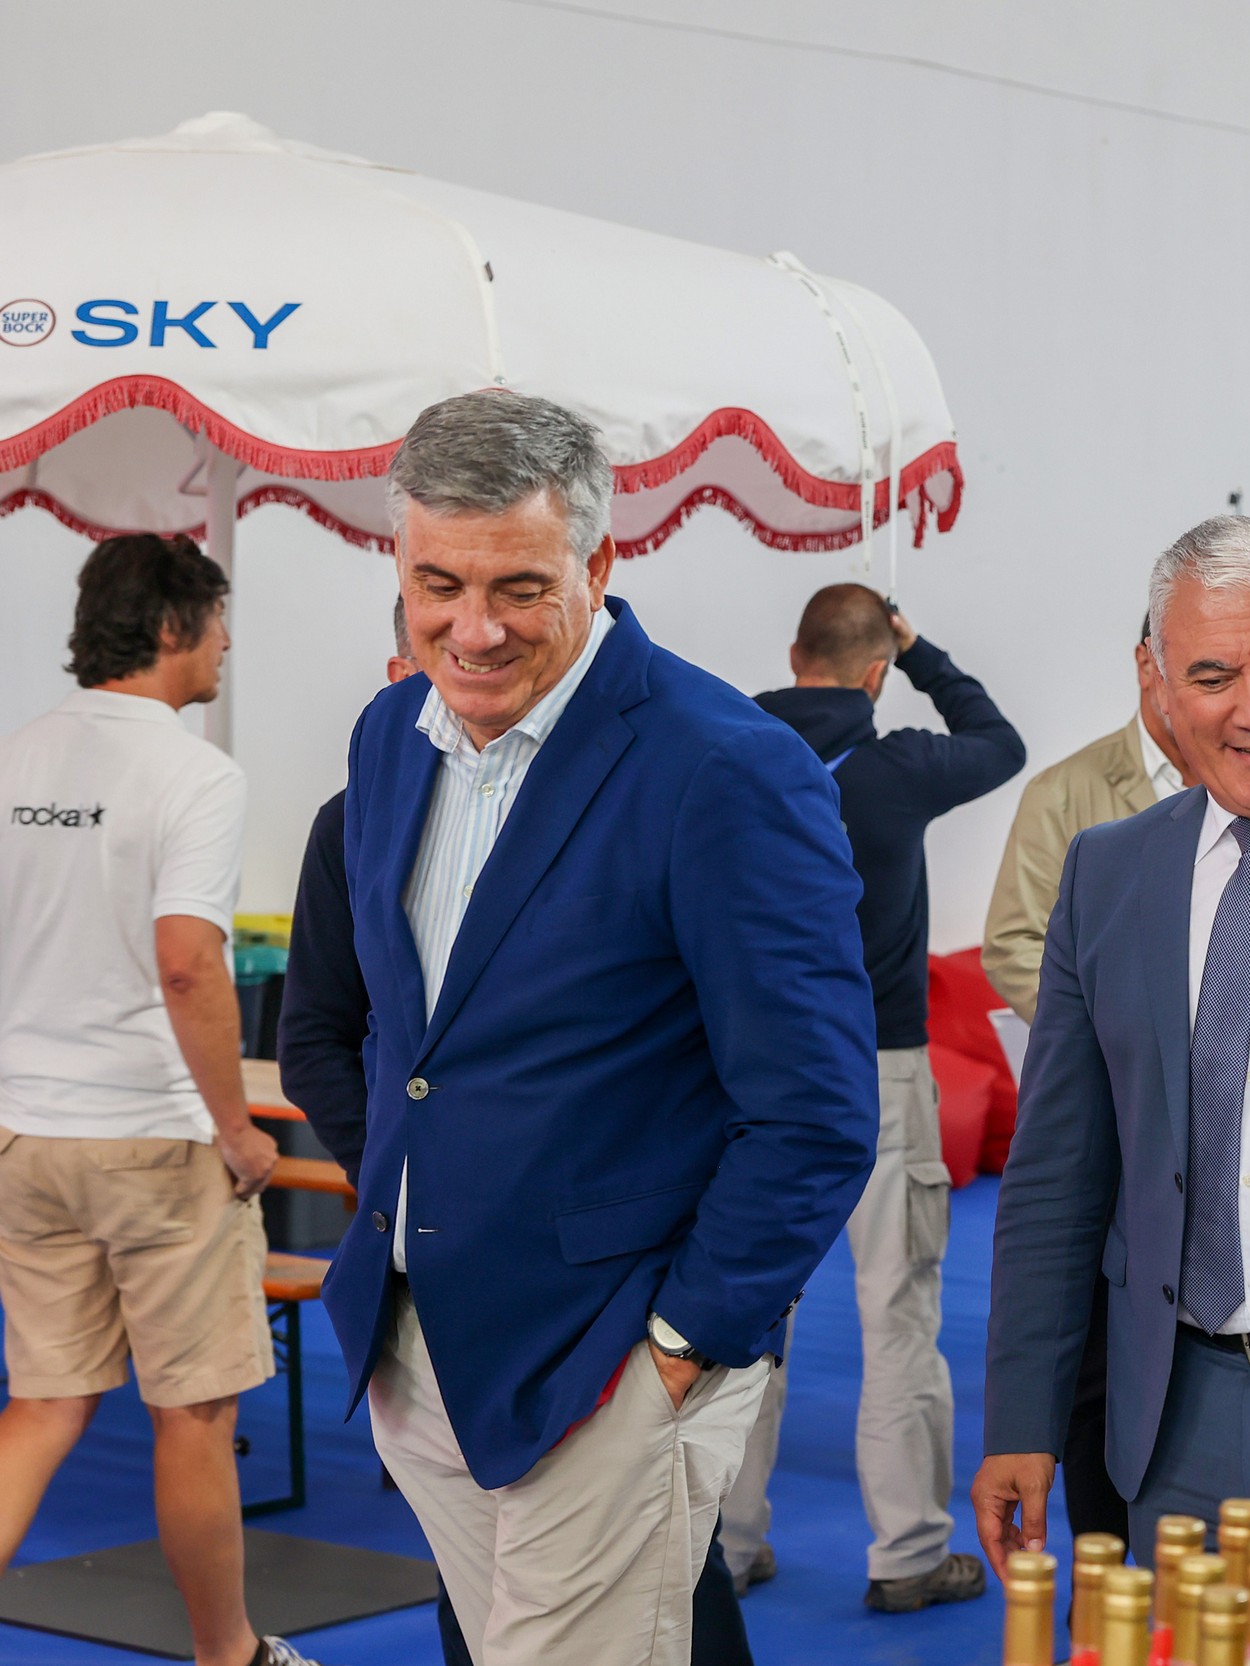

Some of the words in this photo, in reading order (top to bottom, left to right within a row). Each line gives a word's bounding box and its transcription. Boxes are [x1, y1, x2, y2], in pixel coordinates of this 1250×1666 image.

[2, 312, 48, 322] SUPER
[2, 323, 44, 333] BOCK
[71, 299, 302, 349] SKY
